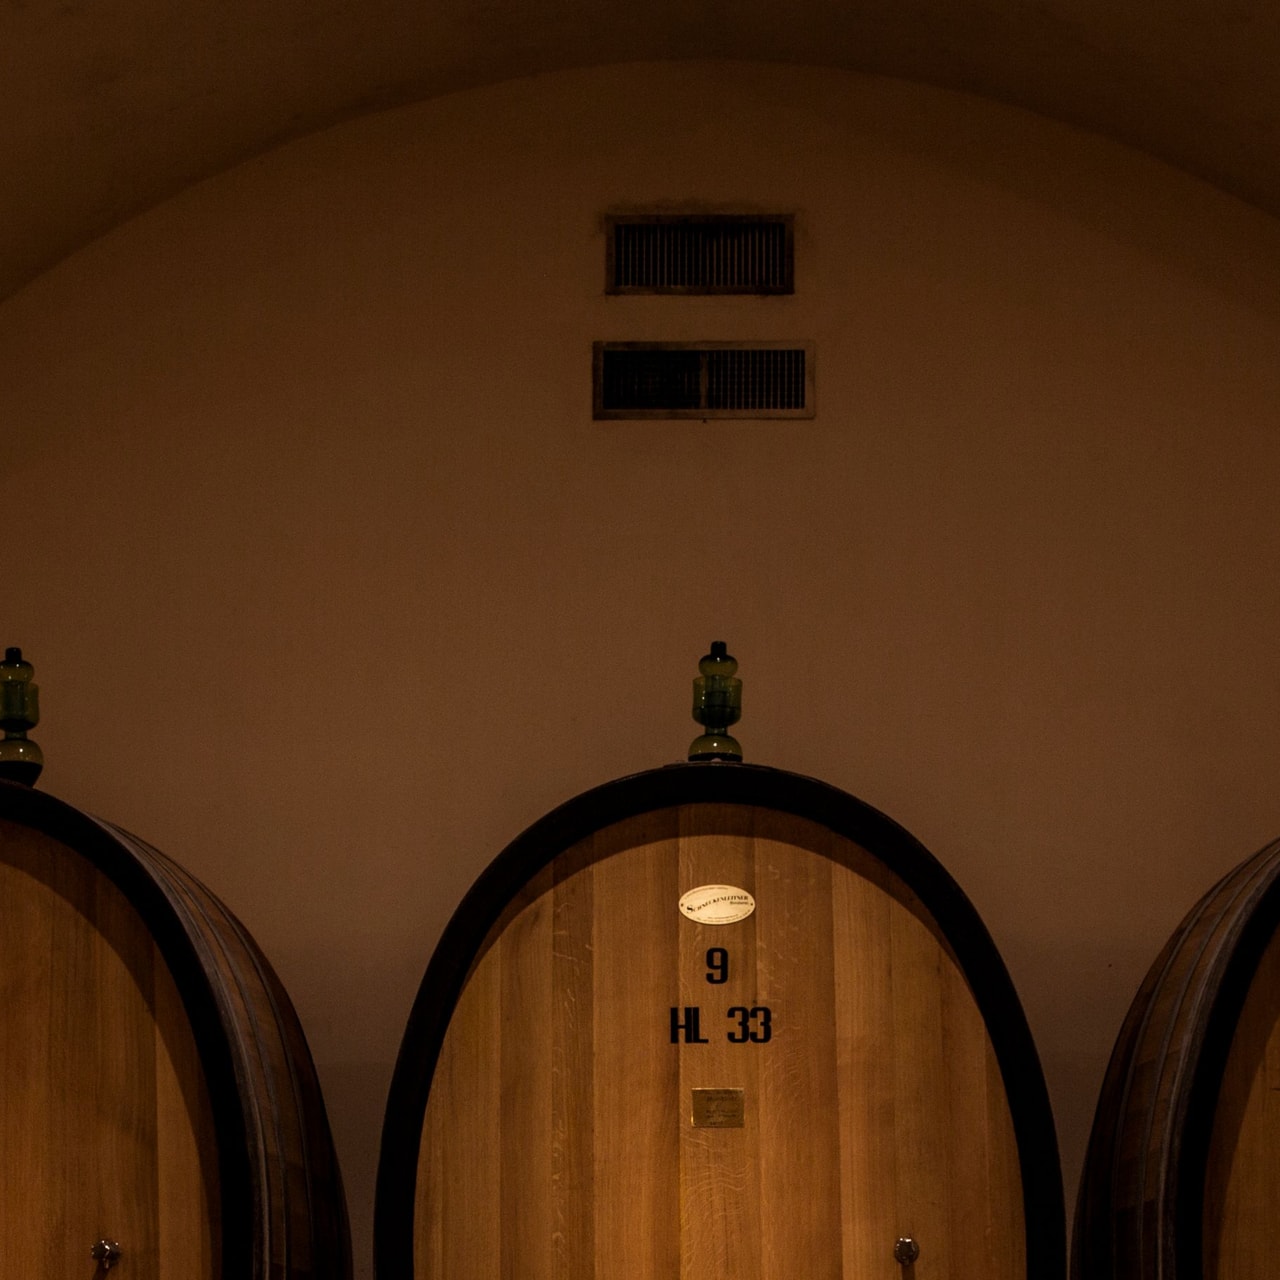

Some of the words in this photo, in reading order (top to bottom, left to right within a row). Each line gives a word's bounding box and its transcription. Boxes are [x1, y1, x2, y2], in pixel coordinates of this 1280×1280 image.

[705, 947, 729, 985] 9
[669, 1006, 709, 1044] HL
[727, 1006, 772, 1044] 33
